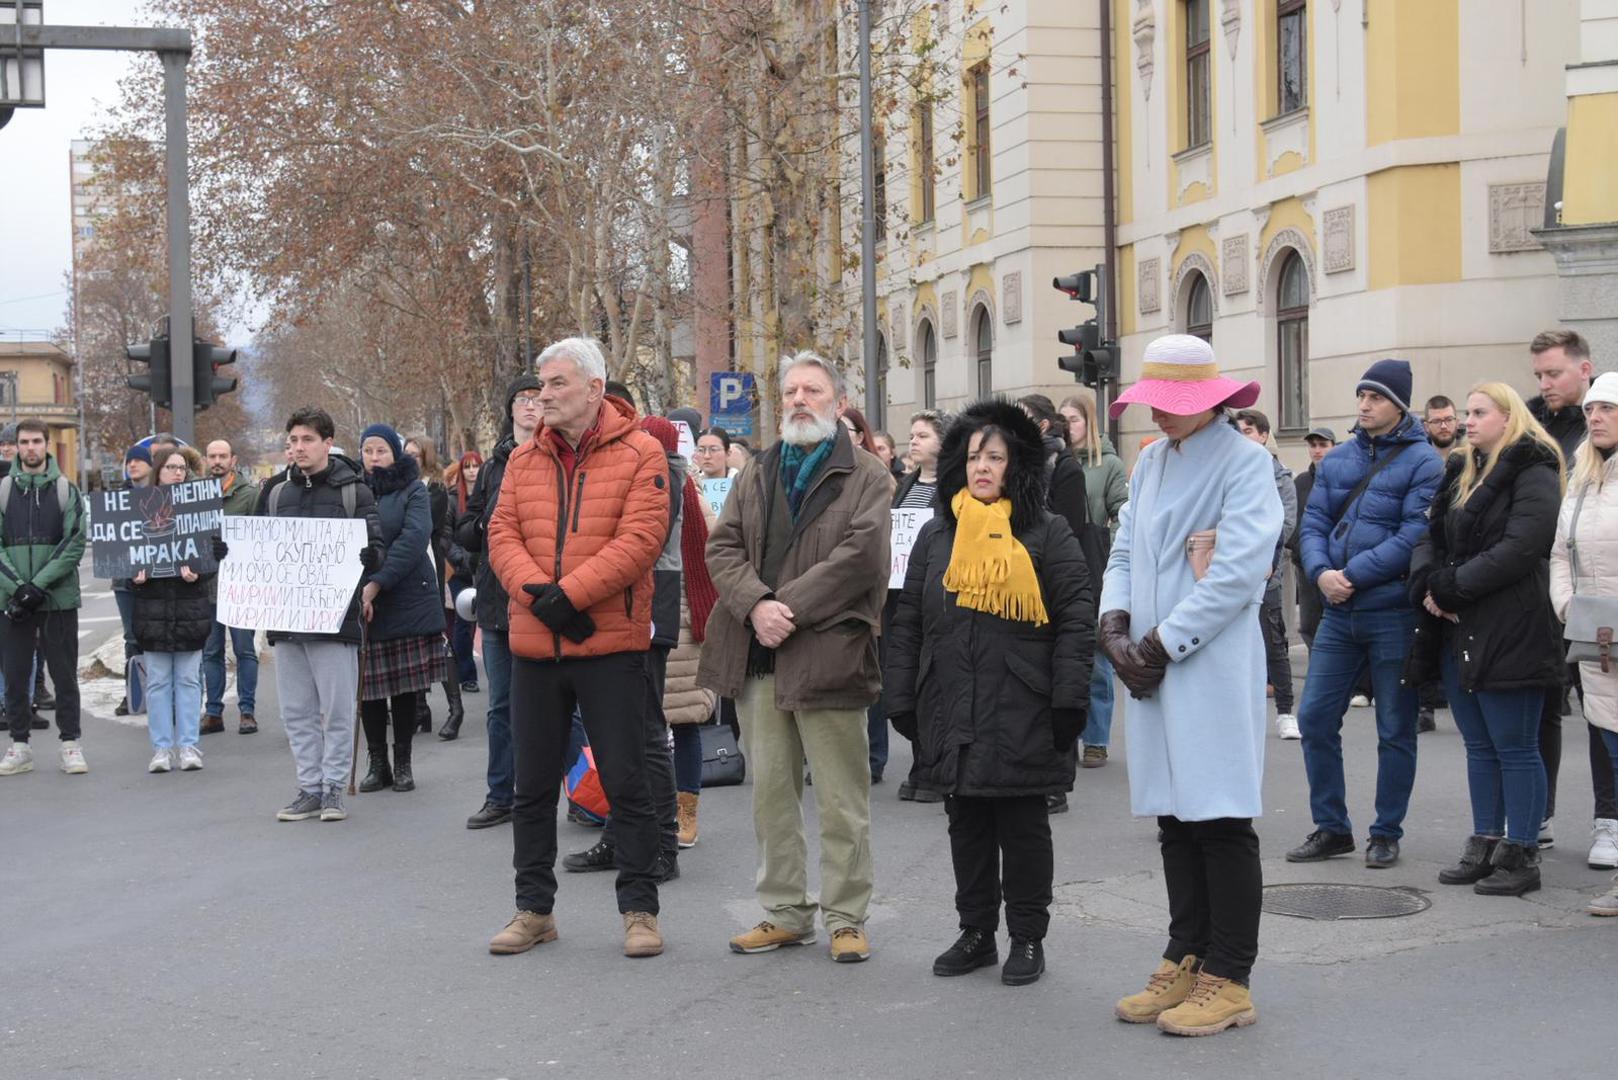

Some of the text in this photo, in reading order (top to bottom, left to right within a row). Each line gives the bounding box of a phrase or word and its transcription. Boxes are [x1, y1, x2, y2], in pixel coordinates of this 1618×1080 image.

[719, 378, 742, 409] P
[104, 491, 131, 512] НЕ
[92, 522, 117, 542] ДА
[120, 520, 144, 541] СЕ
[225, 518, 354, 544] НЕМАМО МИ ШТА ДА
[129, 538, 199, 565] МРАКА
[253, 541, 270, 562] СЕ
[222, 562, 243, 582] МИ
[276, 562, 296, 585] СЕ
[298, 563, 335, 586] ОВДЕ
